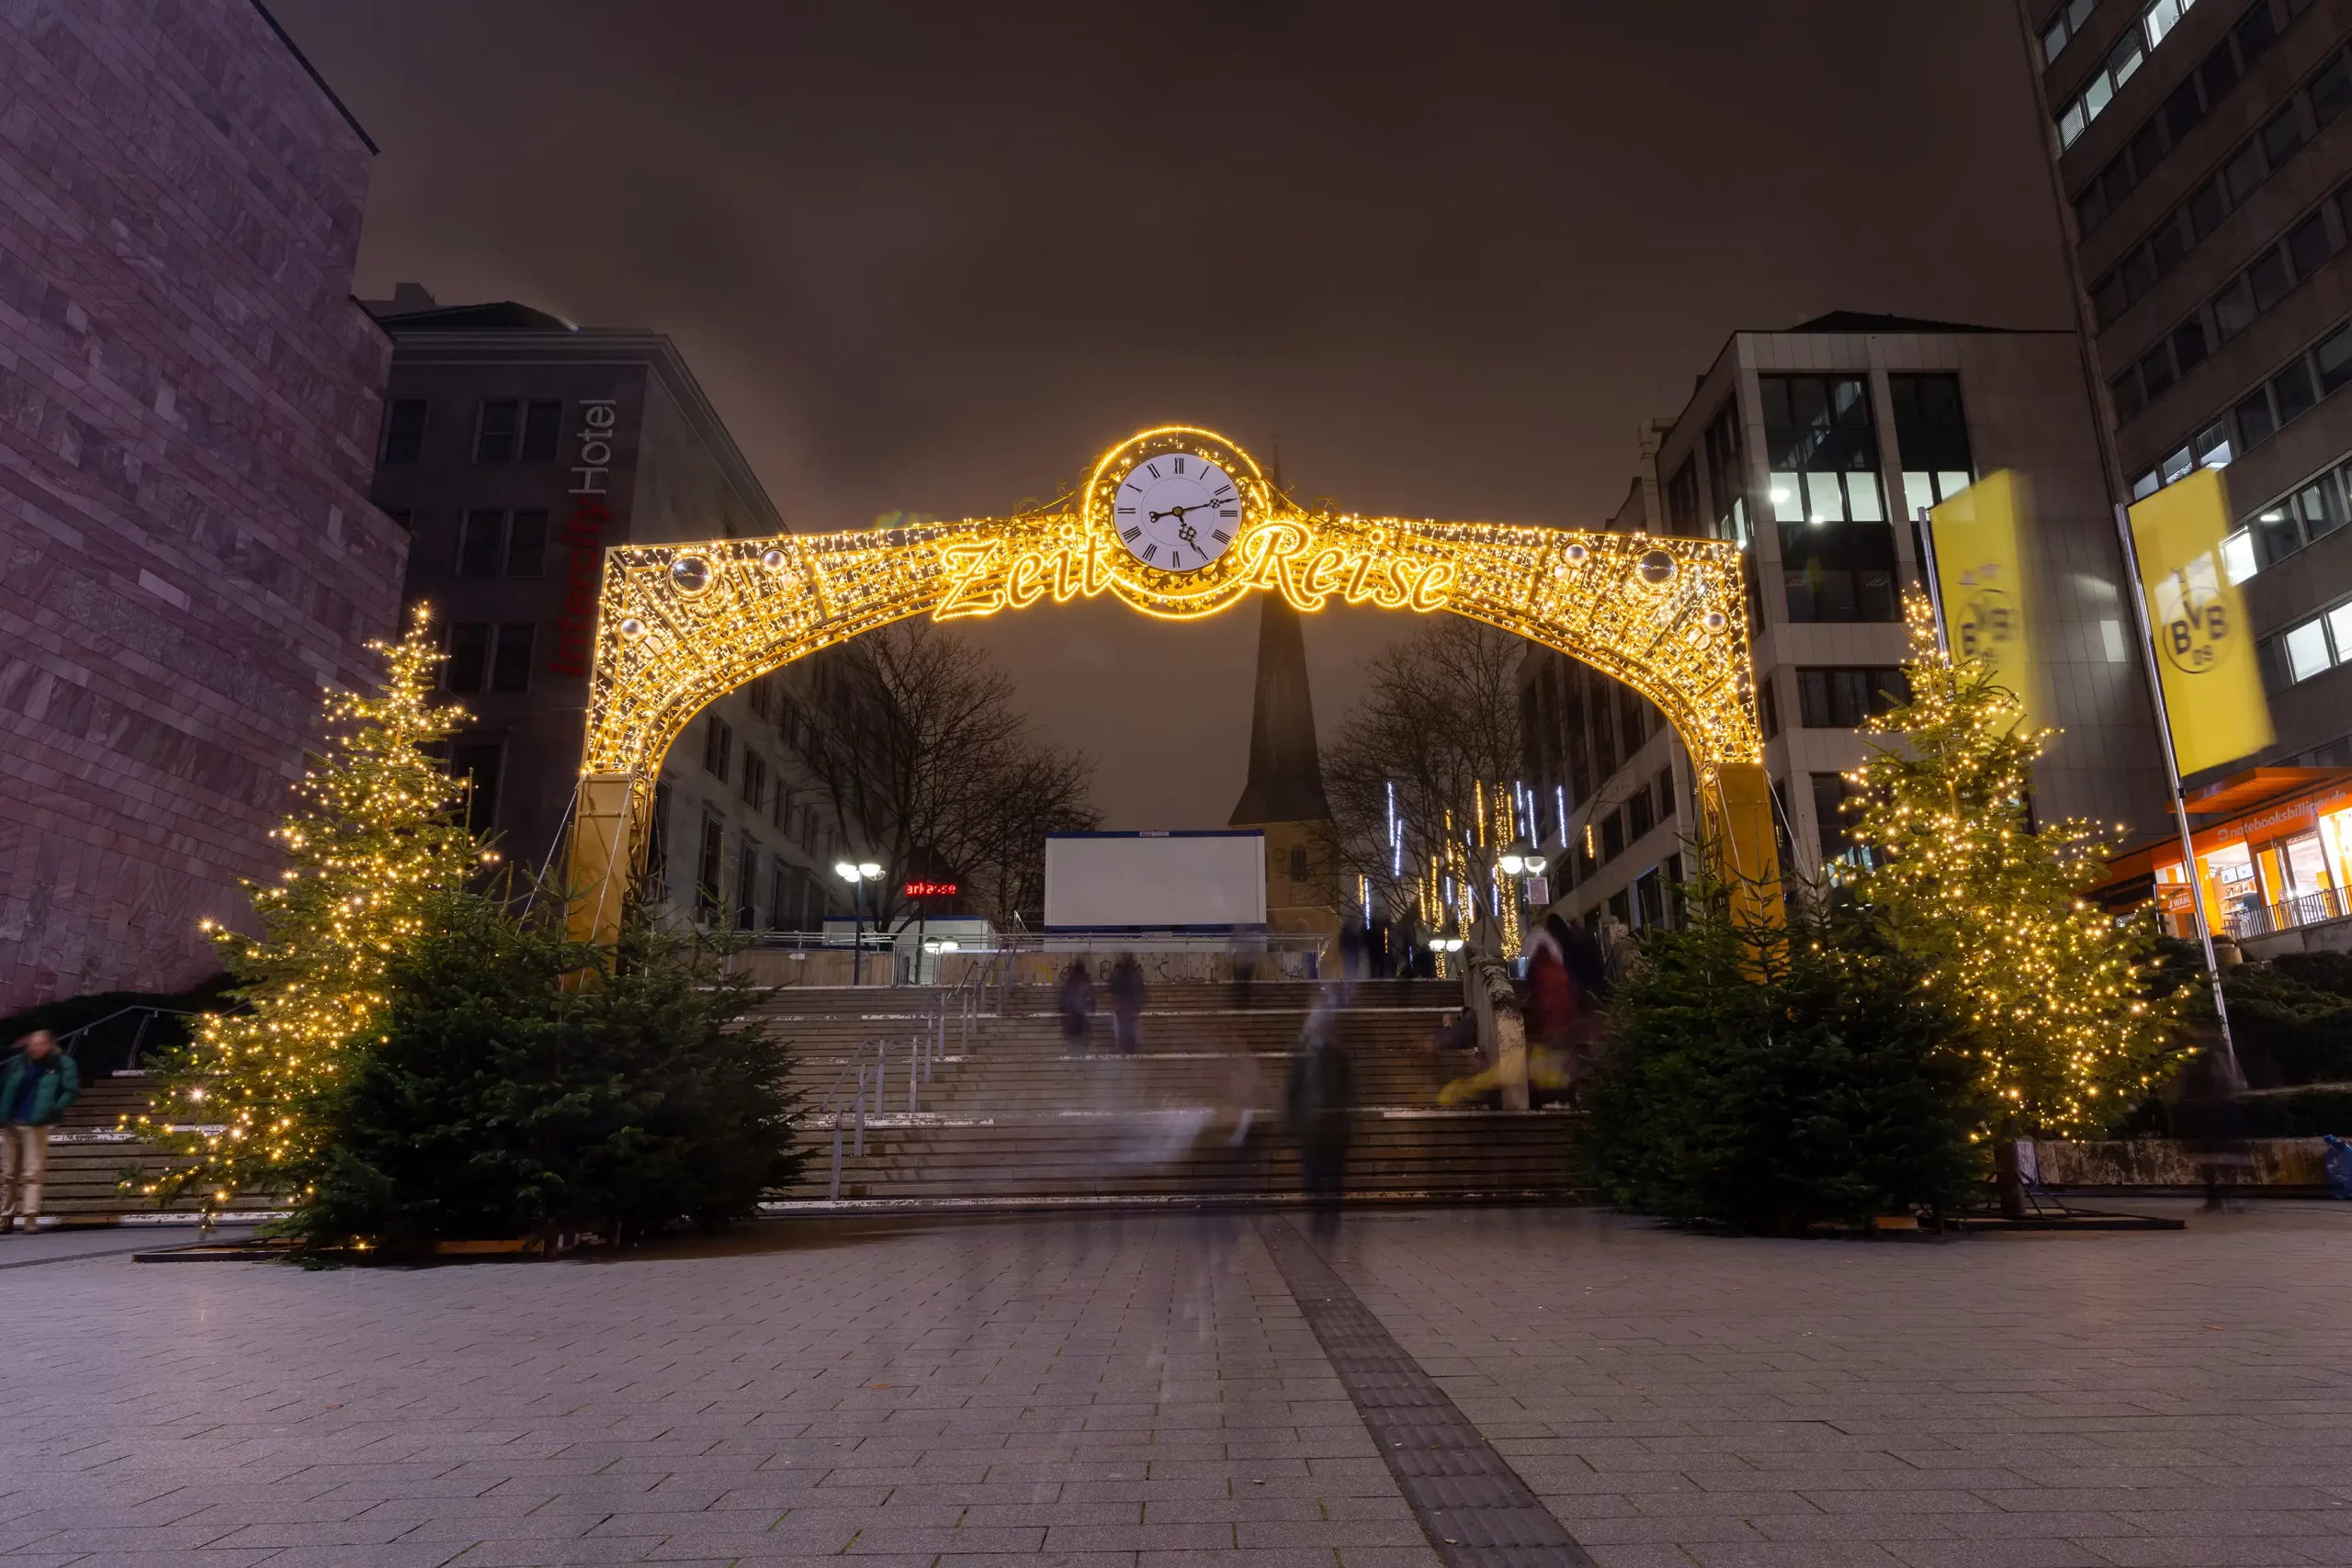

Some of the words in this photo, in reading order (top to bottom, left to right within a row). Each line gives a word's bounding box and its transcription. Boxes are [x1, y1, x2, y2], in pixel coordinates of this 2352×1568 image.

[568, 400, 616, 494] Hotel
[1173, 457, 1184, 475] XII
[1214, 484, 1232, 496] II
[932, 523, 1117, 623] Zeit
[1238, 519, 1456, 613] Reise
[2171, 597, 2230, 655] BVB
[2229, 790, 2347, 840] notebooksbilligerde
[2173, 895, 2192, 908] WAHL
